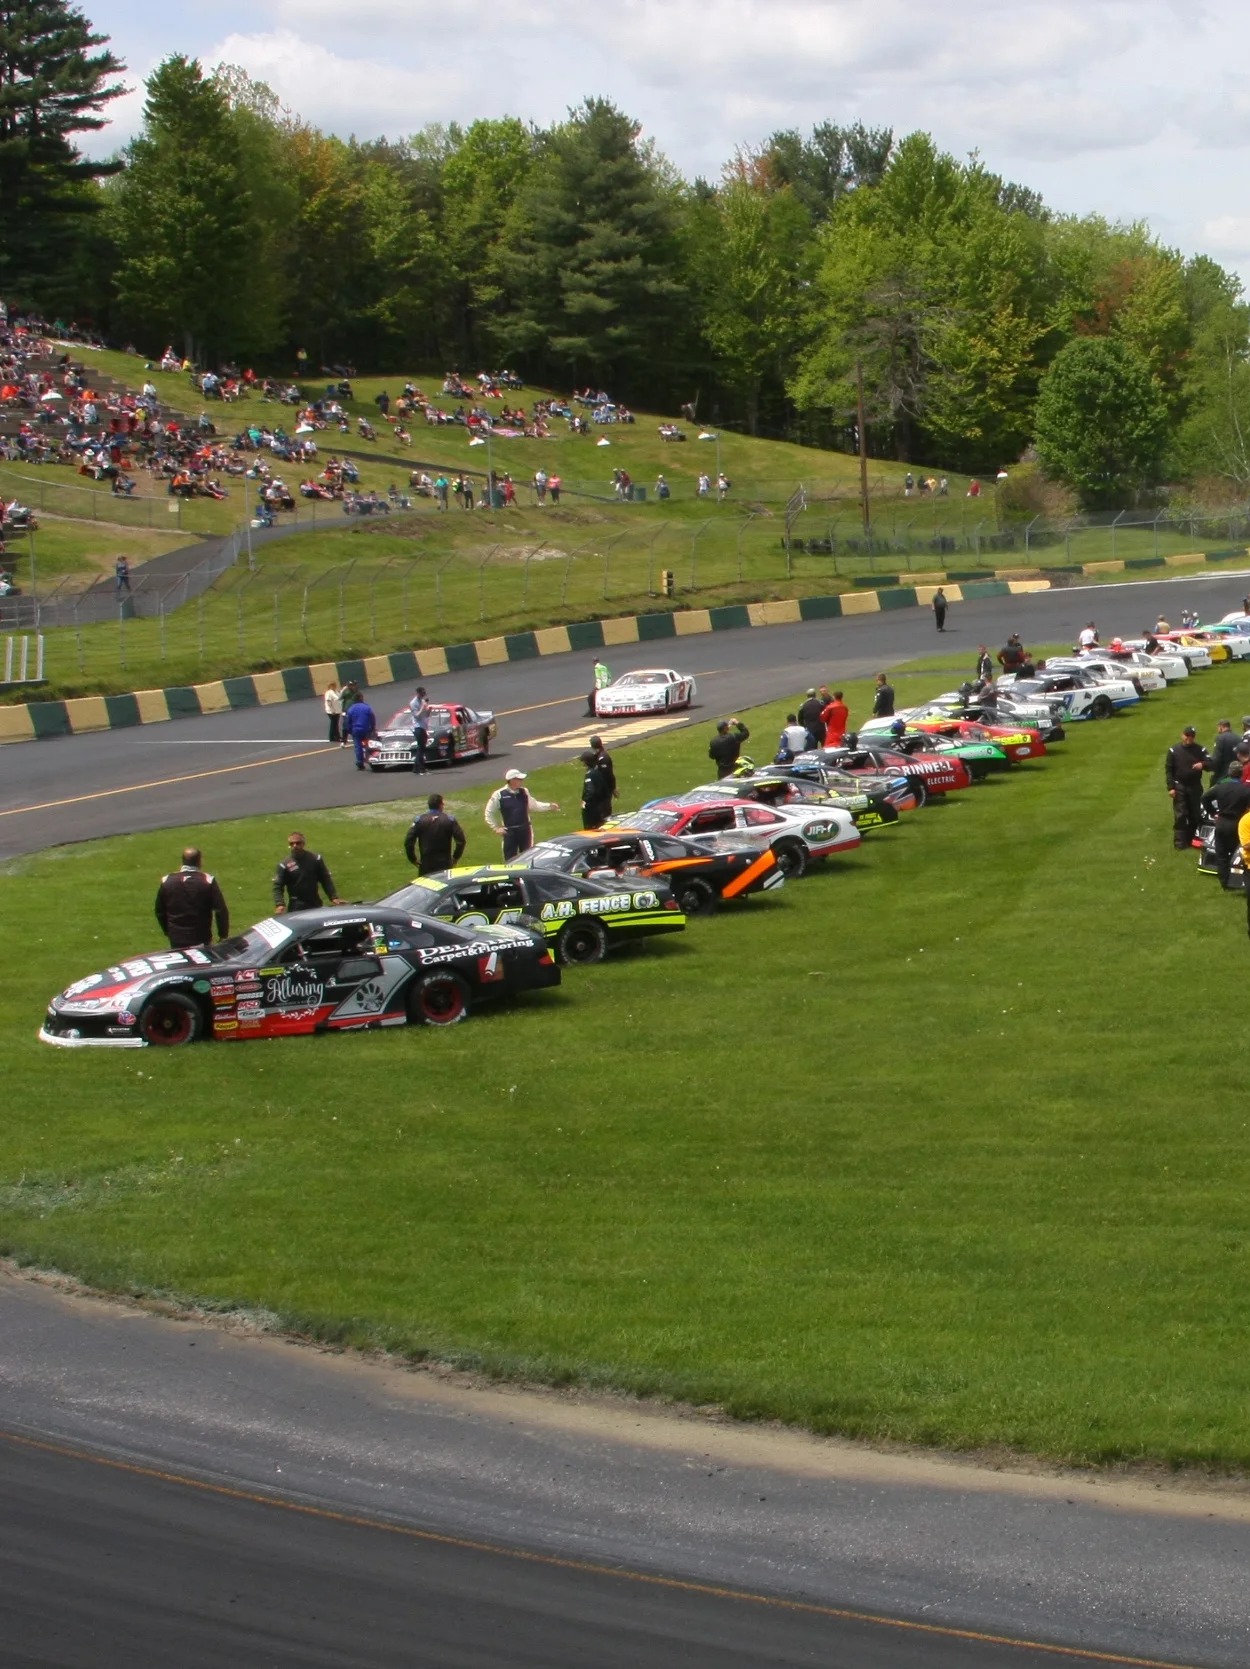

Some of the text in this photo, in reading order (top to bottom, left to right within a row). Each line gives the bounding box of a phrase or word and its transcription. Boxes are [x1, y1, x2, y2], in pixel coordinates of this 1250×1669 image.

[927, 776, 955, 785] ELECTRIC
[541, 902, 576, 920] A.H.
[580, 893, 630, 915] FENCE
[267, 977, 323, 1007] Alluring
